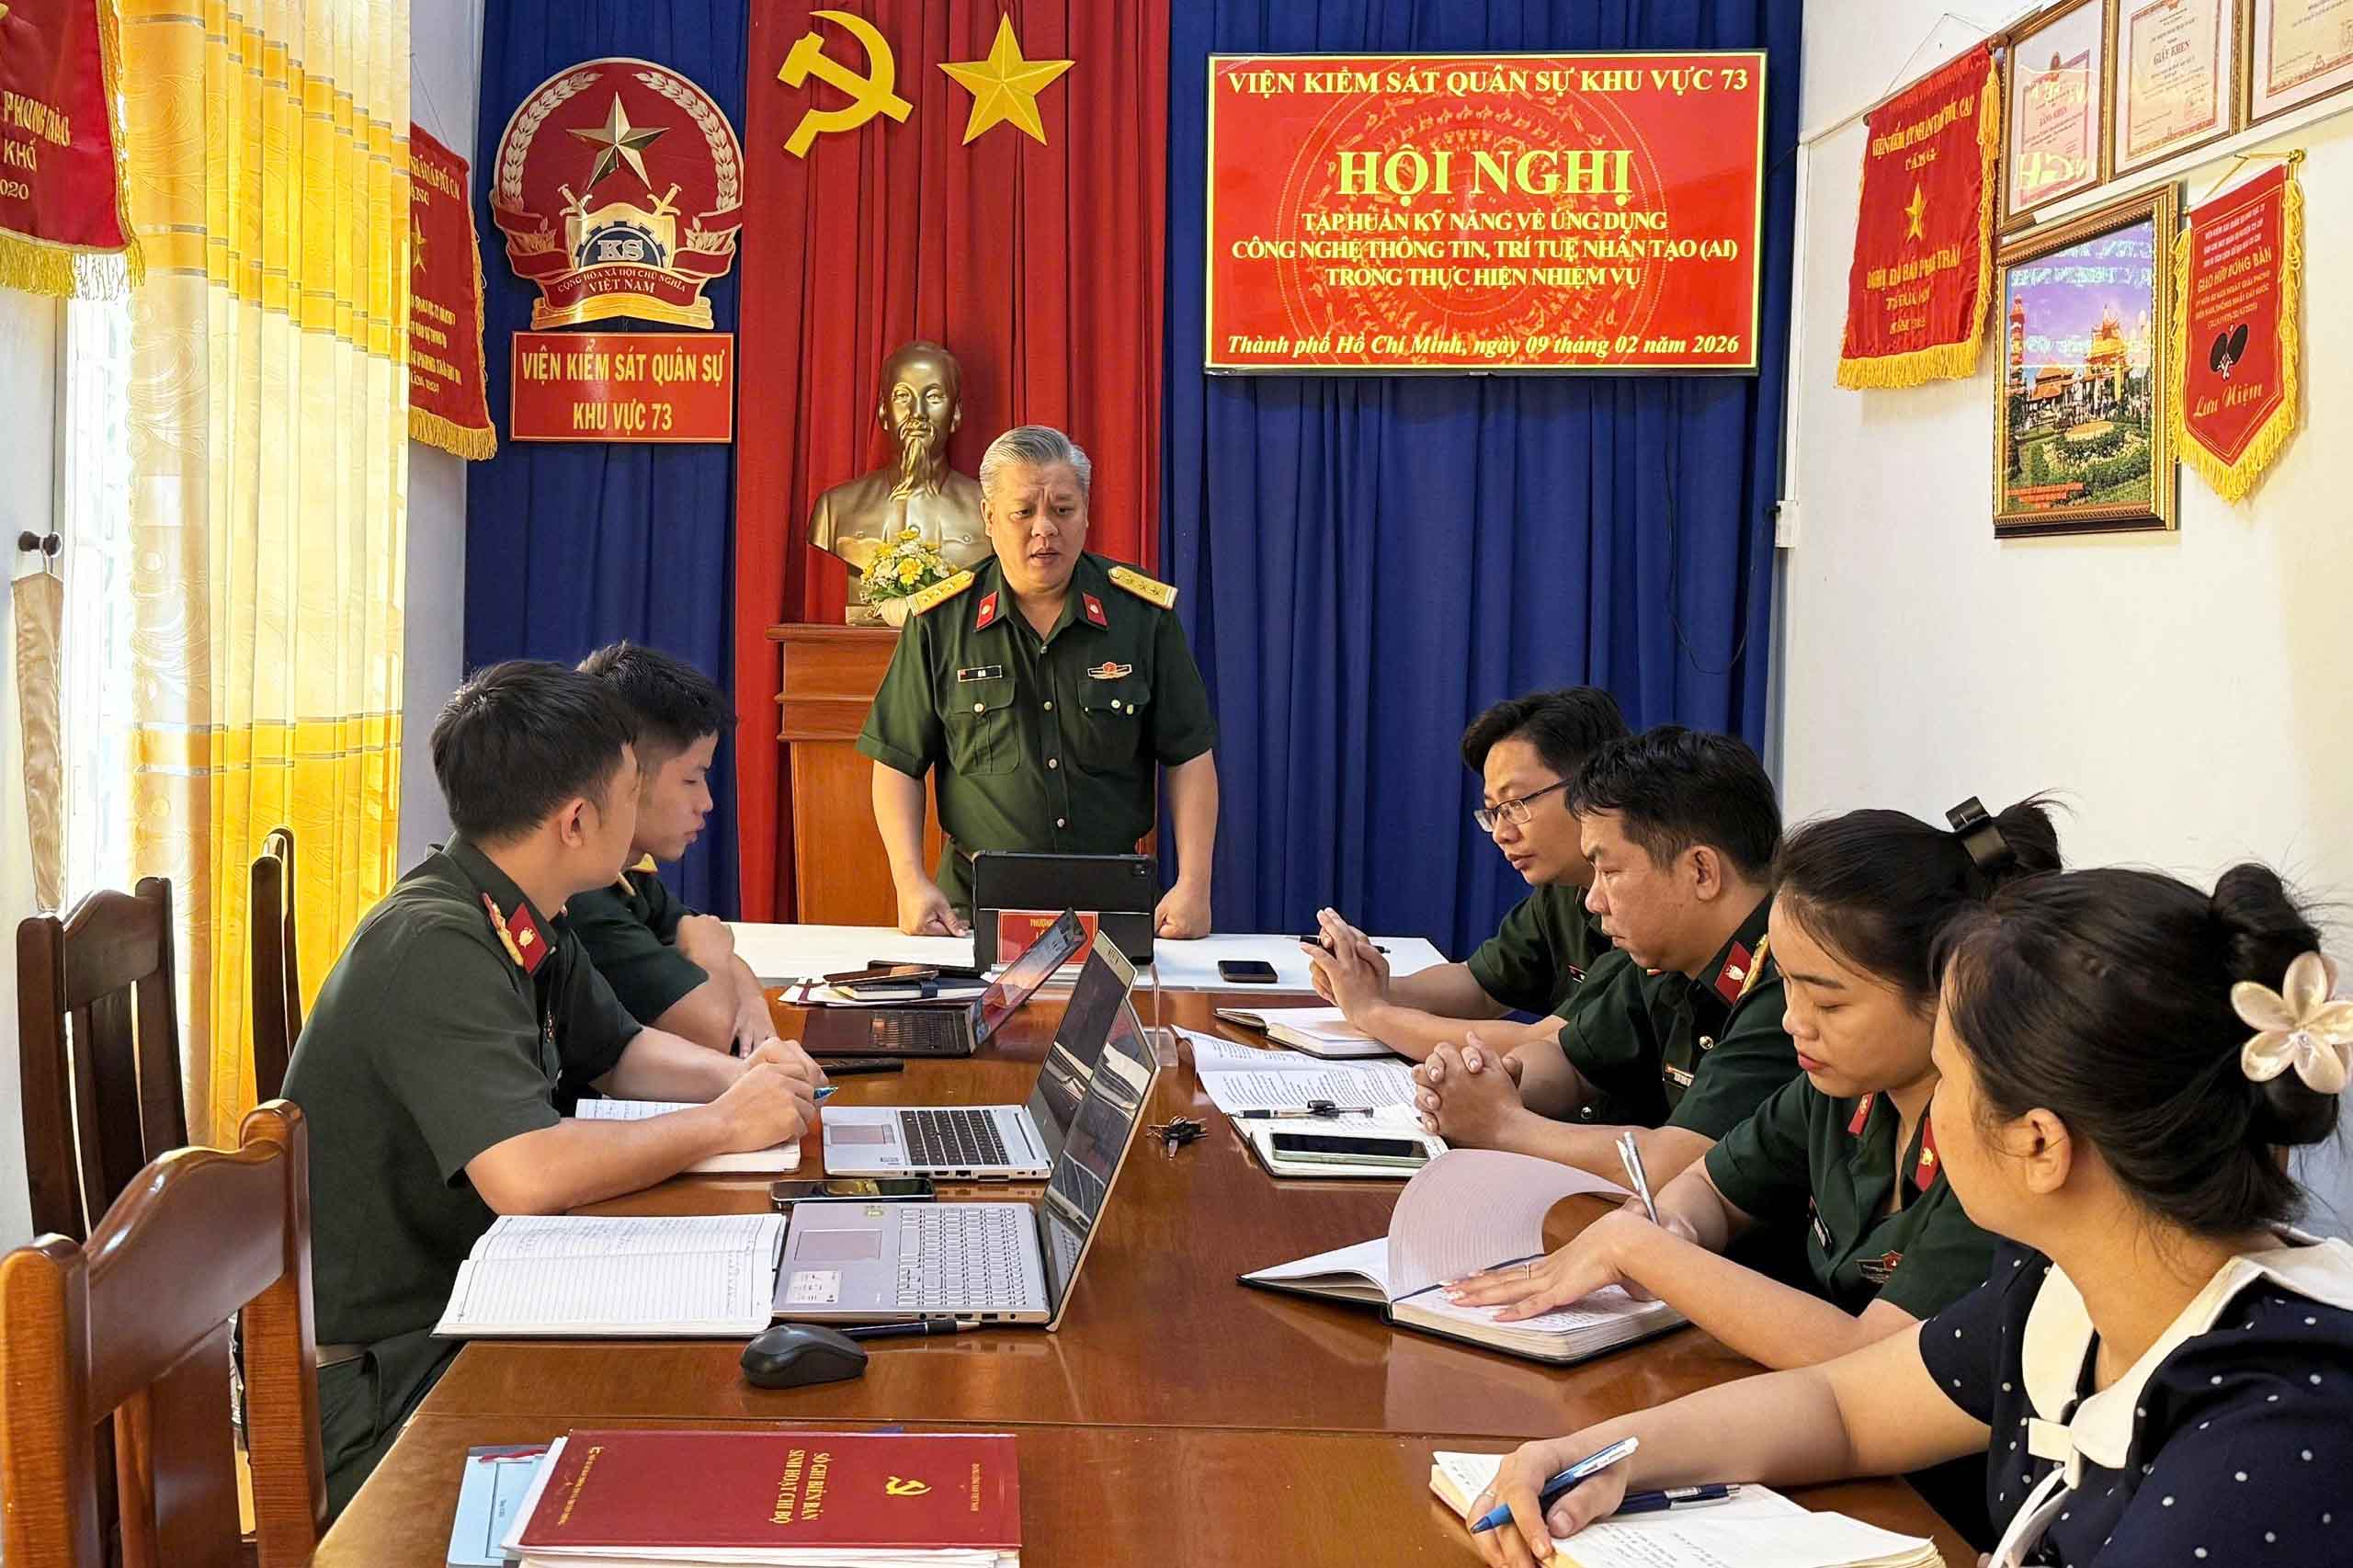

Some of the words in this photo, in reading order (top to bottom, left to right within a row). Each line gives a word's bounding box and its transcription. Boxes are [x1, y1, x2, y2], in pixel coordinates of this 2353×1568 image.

[1228, 69, 1295, 98] VIỆN
[1304, 66, 1379, 94] KIỂM
[1386, 66, 1440, 94] SÁT
[1447, 64, 1529, 97] QUÂN
[1536, 67, 1575, 97] SỰ
[1581, 69, 1643, 92] KHU
[1651, 66, 1712, 96] VỰC
[1721, 69, 1747, 90] 73
[1336, 143, 1452, 207] HỘI
[1470, 149, 1633, 207] NGHỊ
[1302, 212, 1345, 235] TẬP
[1415, 210, 1444, 231] KỸ
[1449, 211, 1512, 231] NĂNG
[1518, 209, 1545, 230] VỀ
[1551, 207, 1602, 231] ỨNG
[1605, 211, 1667, 235] DỤNG
[597, 239, 644, 261] KS
[1232, 235, 1295, 258] CÔNG
[1300, 239, 1363, 263] NGHỆ
[1369, 235, 1444, 258] THÔNG
[1449, 240, 1491, 261] TIN,
[1494, 236, 1530, 258] TRÍ
[1535, 239, 1578, 262] TUỆ
[1651, 240, 1697, 262] TẠO
[1699, 239, 1737, 261] (AI)
[558, 277, 582, 292] CỘNG
[619, 267, 637, 278] HỘI
[589, 278, 620, 293] VIỆT
[624, 278, 655, 293] NAM
[1325, 267, 1403, 287] TRONG
[1407, 266, 1470, 290] THỰC
[1473, 266, 1527, 290] HIỆN
[1531, 266, 1605, 290] NHIỆM
[1609, 267, 1641, 290] VỤ
[1228, 334, 1290, 354] Thành
[1293, 330, 1332, 359] phố
[1336, 330, 1367, 355] Hồ
[1378, 333, 1405, 354] Chí
[1410, 335, 1468, 358] Minh,
[1472, 336, 1519, 360] ngày
[1526, 335, 1550, 355] 09
[1553, 335, 1609, 359] tháng
[1615, 335, 1639, 355] 02
[1643, 336, 1686, 355] năm
[1692, 335, 1740, 355] 2026
[522, 345, 562, 386] VIỆN
[566, 338, 609, 382] KIỂM
[615, 346, 646, 382] SÁT
[652, 346, 697, 387] QUÂN
[701, 348, 725, 387] SỰ
[573, 403, 608, 430] KHU
[613, 398, 646, 436] VỰC
[652, 403, 673, 431] 73
[786, 1449, 806, 1468] SINH
[813, 1452, 834, 1463] SỔ
[778, 1469, 801, 1492] HOẠT
[809, 1464, 827, 1479] GHI
[777, 1493, 796, 1509] CHI
[805, 1481, 828, 1501] BIÊN
[768, 1511, 793, 1524] BỘ
[801, 1502, 824, 1520] BẢN
